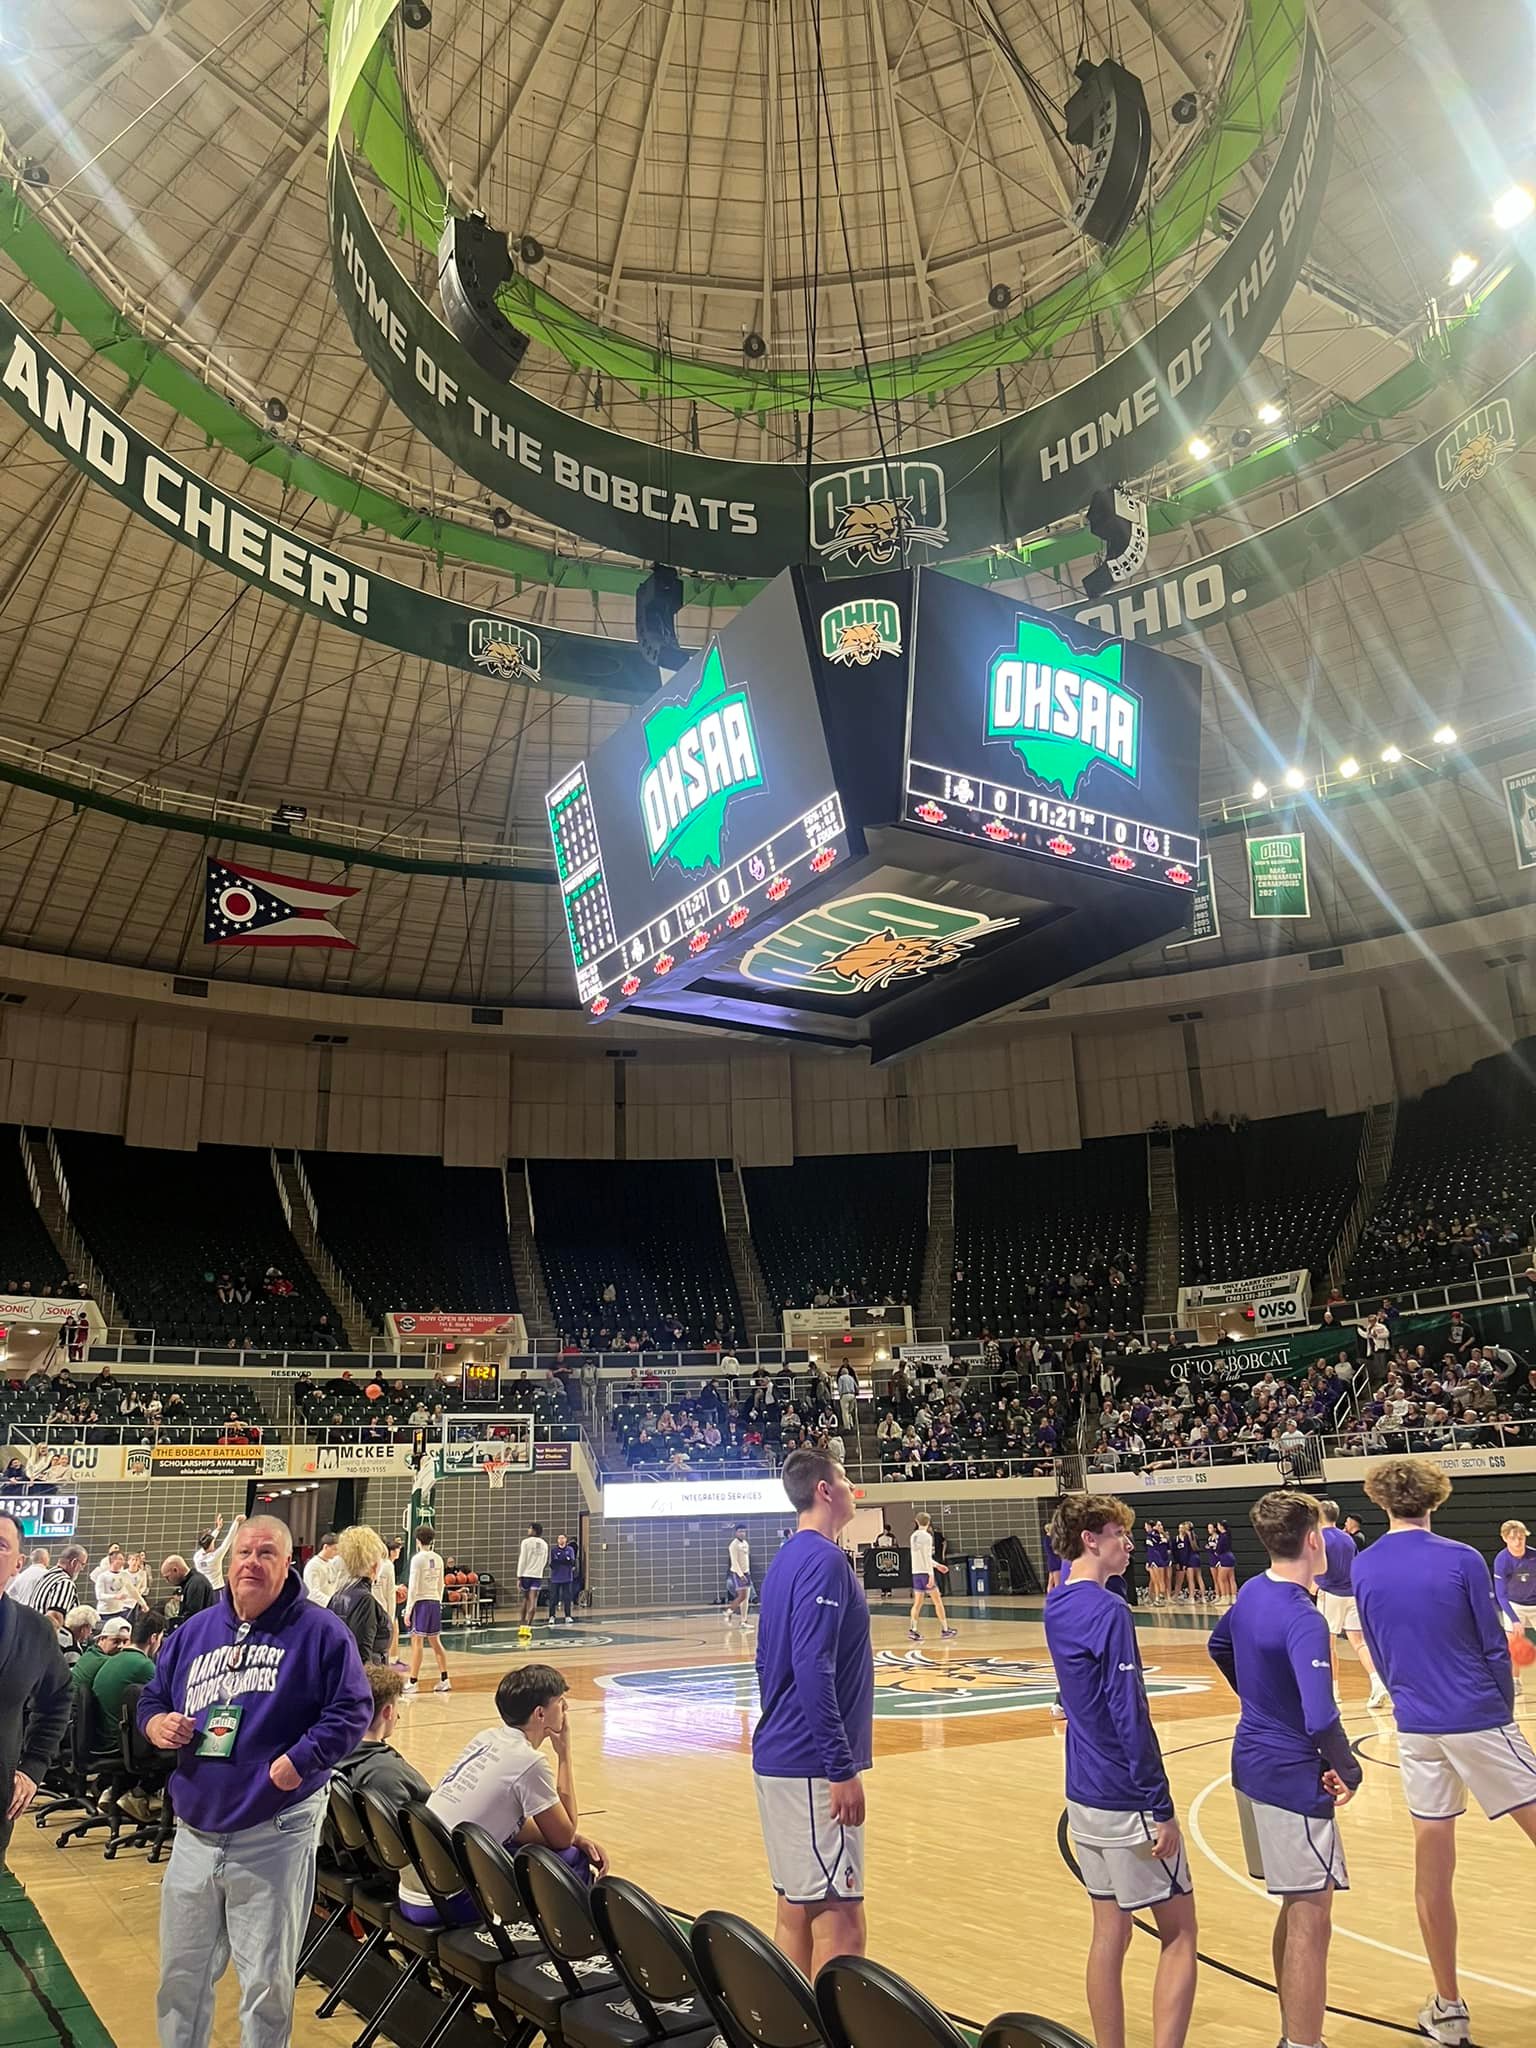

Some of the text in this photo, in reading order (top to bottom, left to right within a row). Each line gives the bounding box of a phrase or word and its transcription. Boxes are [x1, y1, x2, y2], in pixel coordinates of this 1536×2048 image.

[1040, 378, 1159, 482] HOME
[1167, 321, 1212, 398] OF
[1220, 229, 1276, 337] THE
[341, 213, 758, 535] HOME OF THE BOBCATS
[2, 334, 370, 625] AND CHEER!
[809, 462, 947, 550] OHIO
[1075, 564, 1247, 640] OHIO.
[821, 599, 901, 659] OHIO
[469, 619, 540, 674] OHIO
[994, 660, 1137, 767] OHSAA
[643, 701, 758, 857] OHSAA
[994, 790, 1007, 811] 0
[1028, 799, 1077, 831] 11:21
[1115, 822, 1127, 843] 0
[1261, 842, 1292, 859] OHIO
[659, 878, 730, 944] 0 11:21 0
[0, 1305, 29, 1313] SONIC
[46, 1307, 76, 1315] SONIC
[1258, 1300, 1296, 1319] OVSO
[1228, 1348, 1291, 1372] BOBCAT
[469, 1366, 496, 1379] 11:21
[159, 1460, 215, 1468] SCHOLARSHIPS
[175, 1449, 211, 1457] BOBCAT
[213, 1449, 261, 1457] BATTALION
[340, 1446, 395, 1458] McKEE
[1462, 1458, 1486, 1467] SECTION
[681, 1491, 763, 1502] INTEGRATED SERVICES
[53, 1507, 65, 1524] 0
[247, 1644, 286, 1666] FERRY
[184, 1672, 223, 1716] PURPLE
